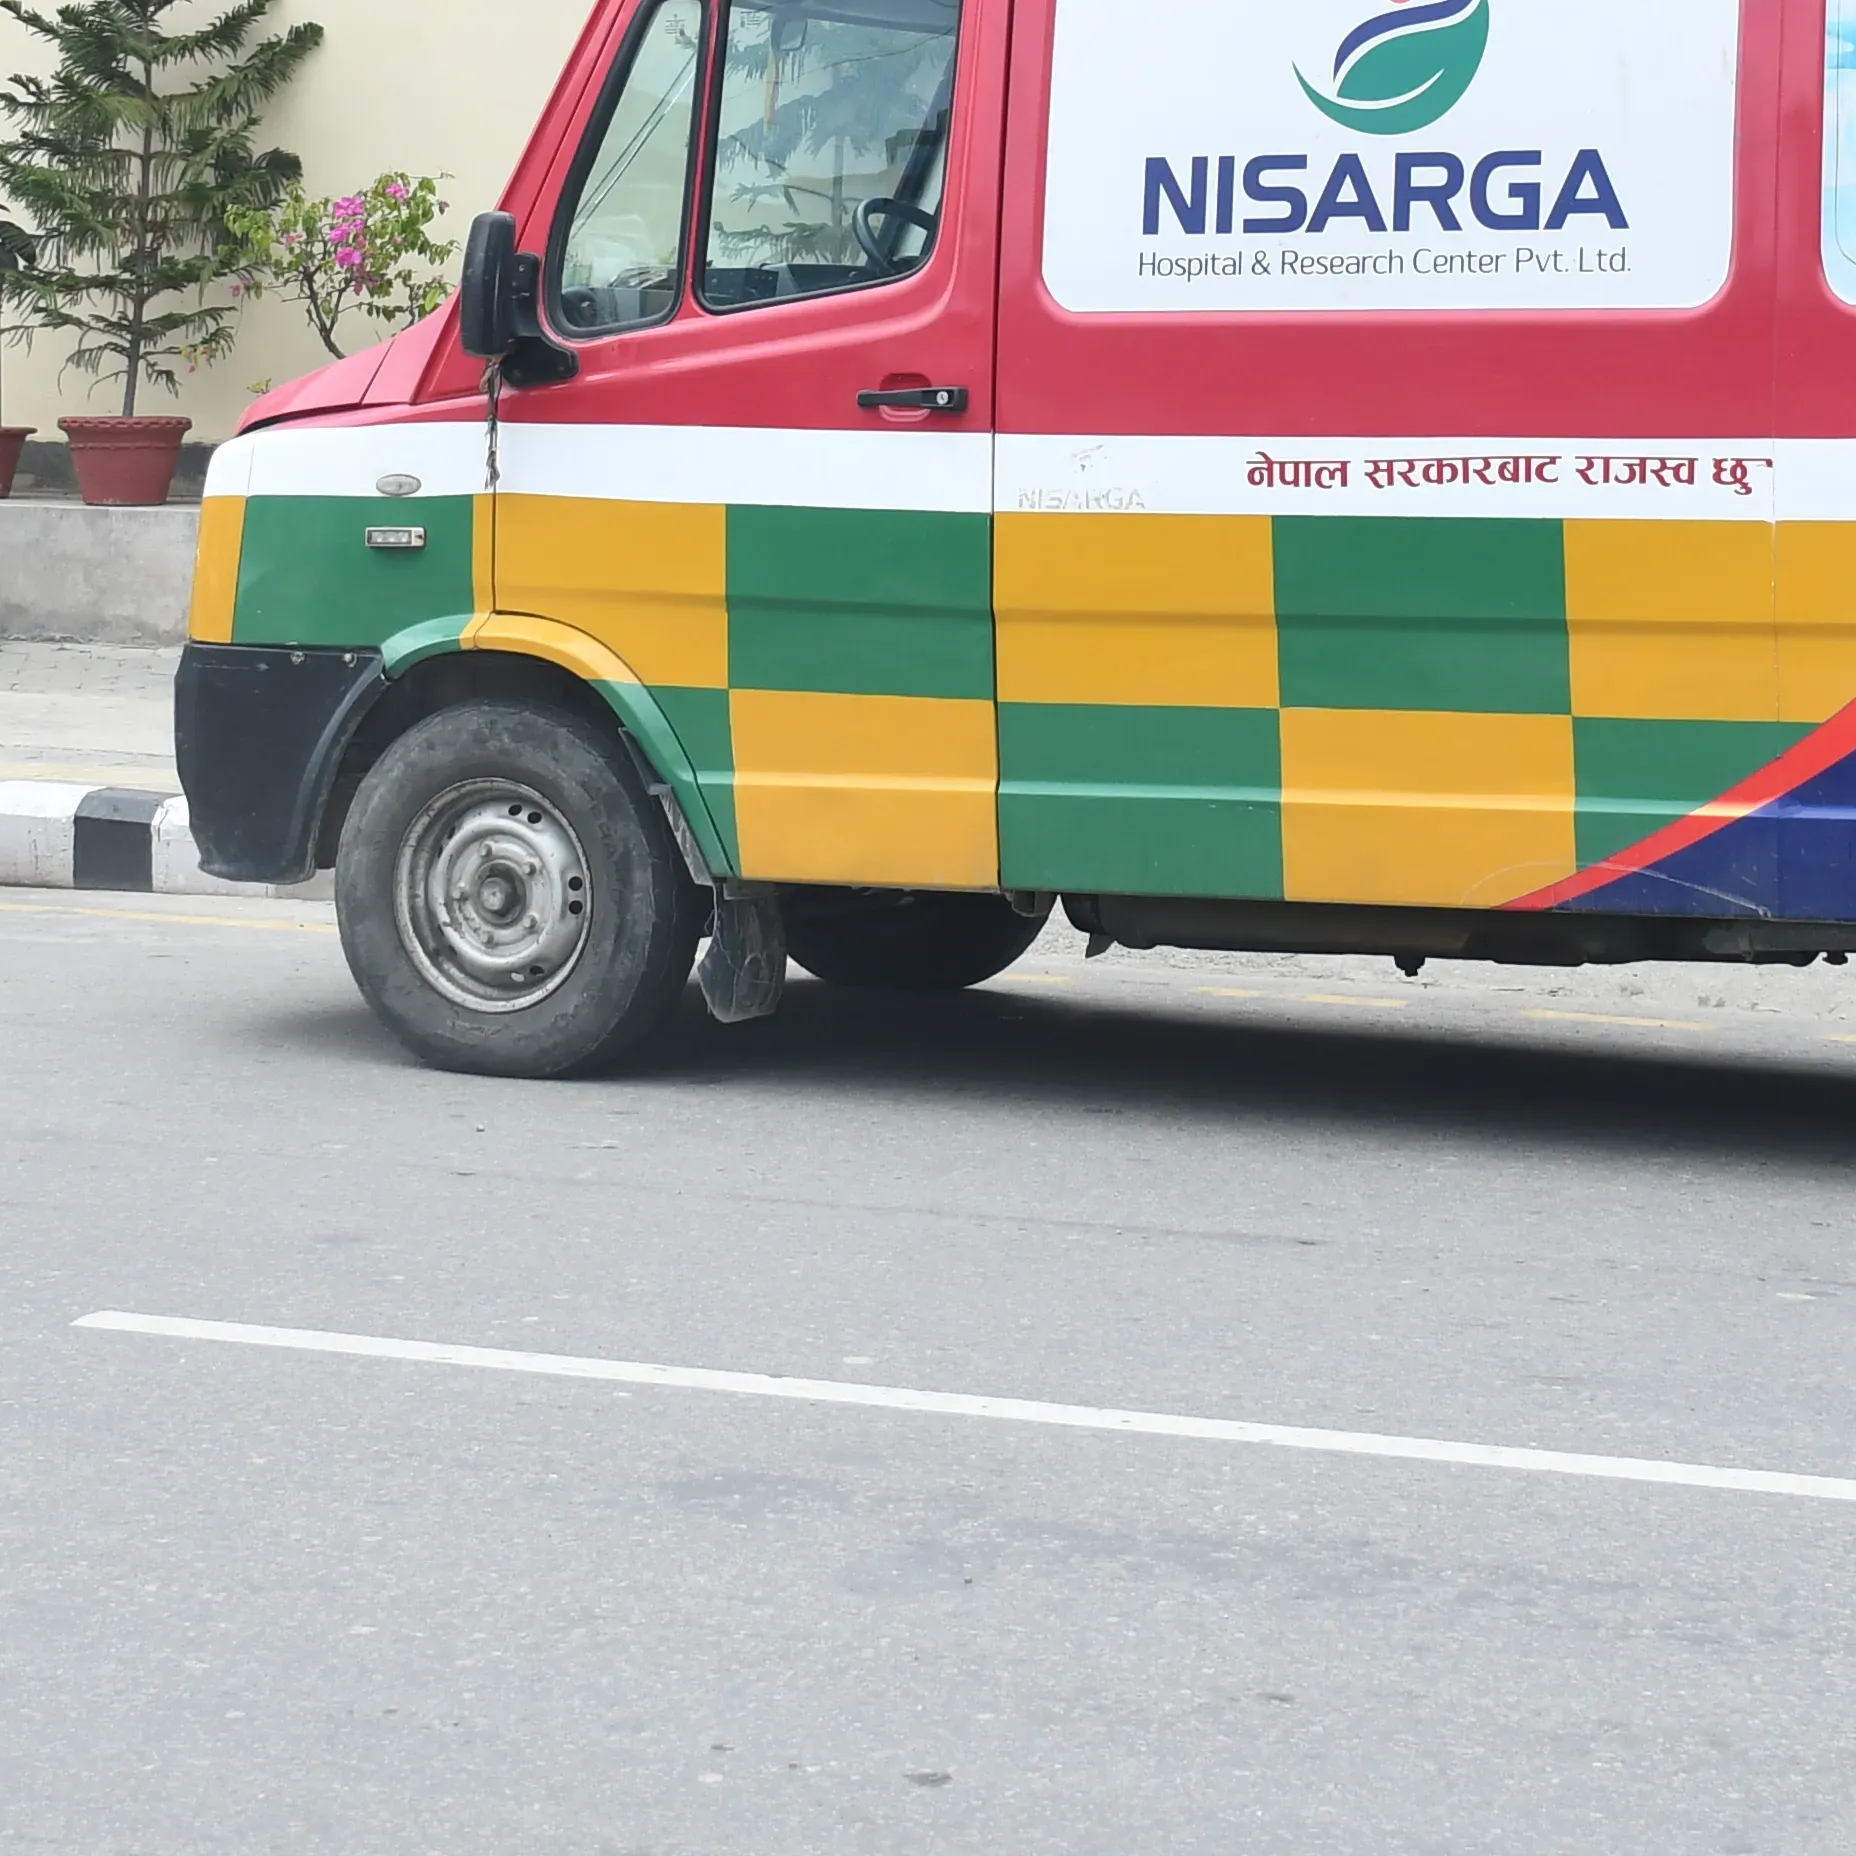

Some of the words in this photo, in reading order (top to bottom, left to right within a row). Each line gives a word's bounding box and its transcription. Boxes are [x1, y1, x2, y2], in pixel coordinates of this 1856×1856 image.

[1141, 148, 1630, 236] NISARGA
[1138, 250, 1243, 282] Hospital
[1251, 250, 1271, 277] &
[1280, 248, 1404, 276] Research
[1412, 248, 1506, 275] Center
[1515, 248, 1570, 274] Pvt.
[1578, 247, 1632, 274] Ltd.
[1246, 451, 1349, 489] नेपाल
[1363, 455, 1563, 488] सरकारबाट
[1575, 455, 1698, 486] राजस्व
